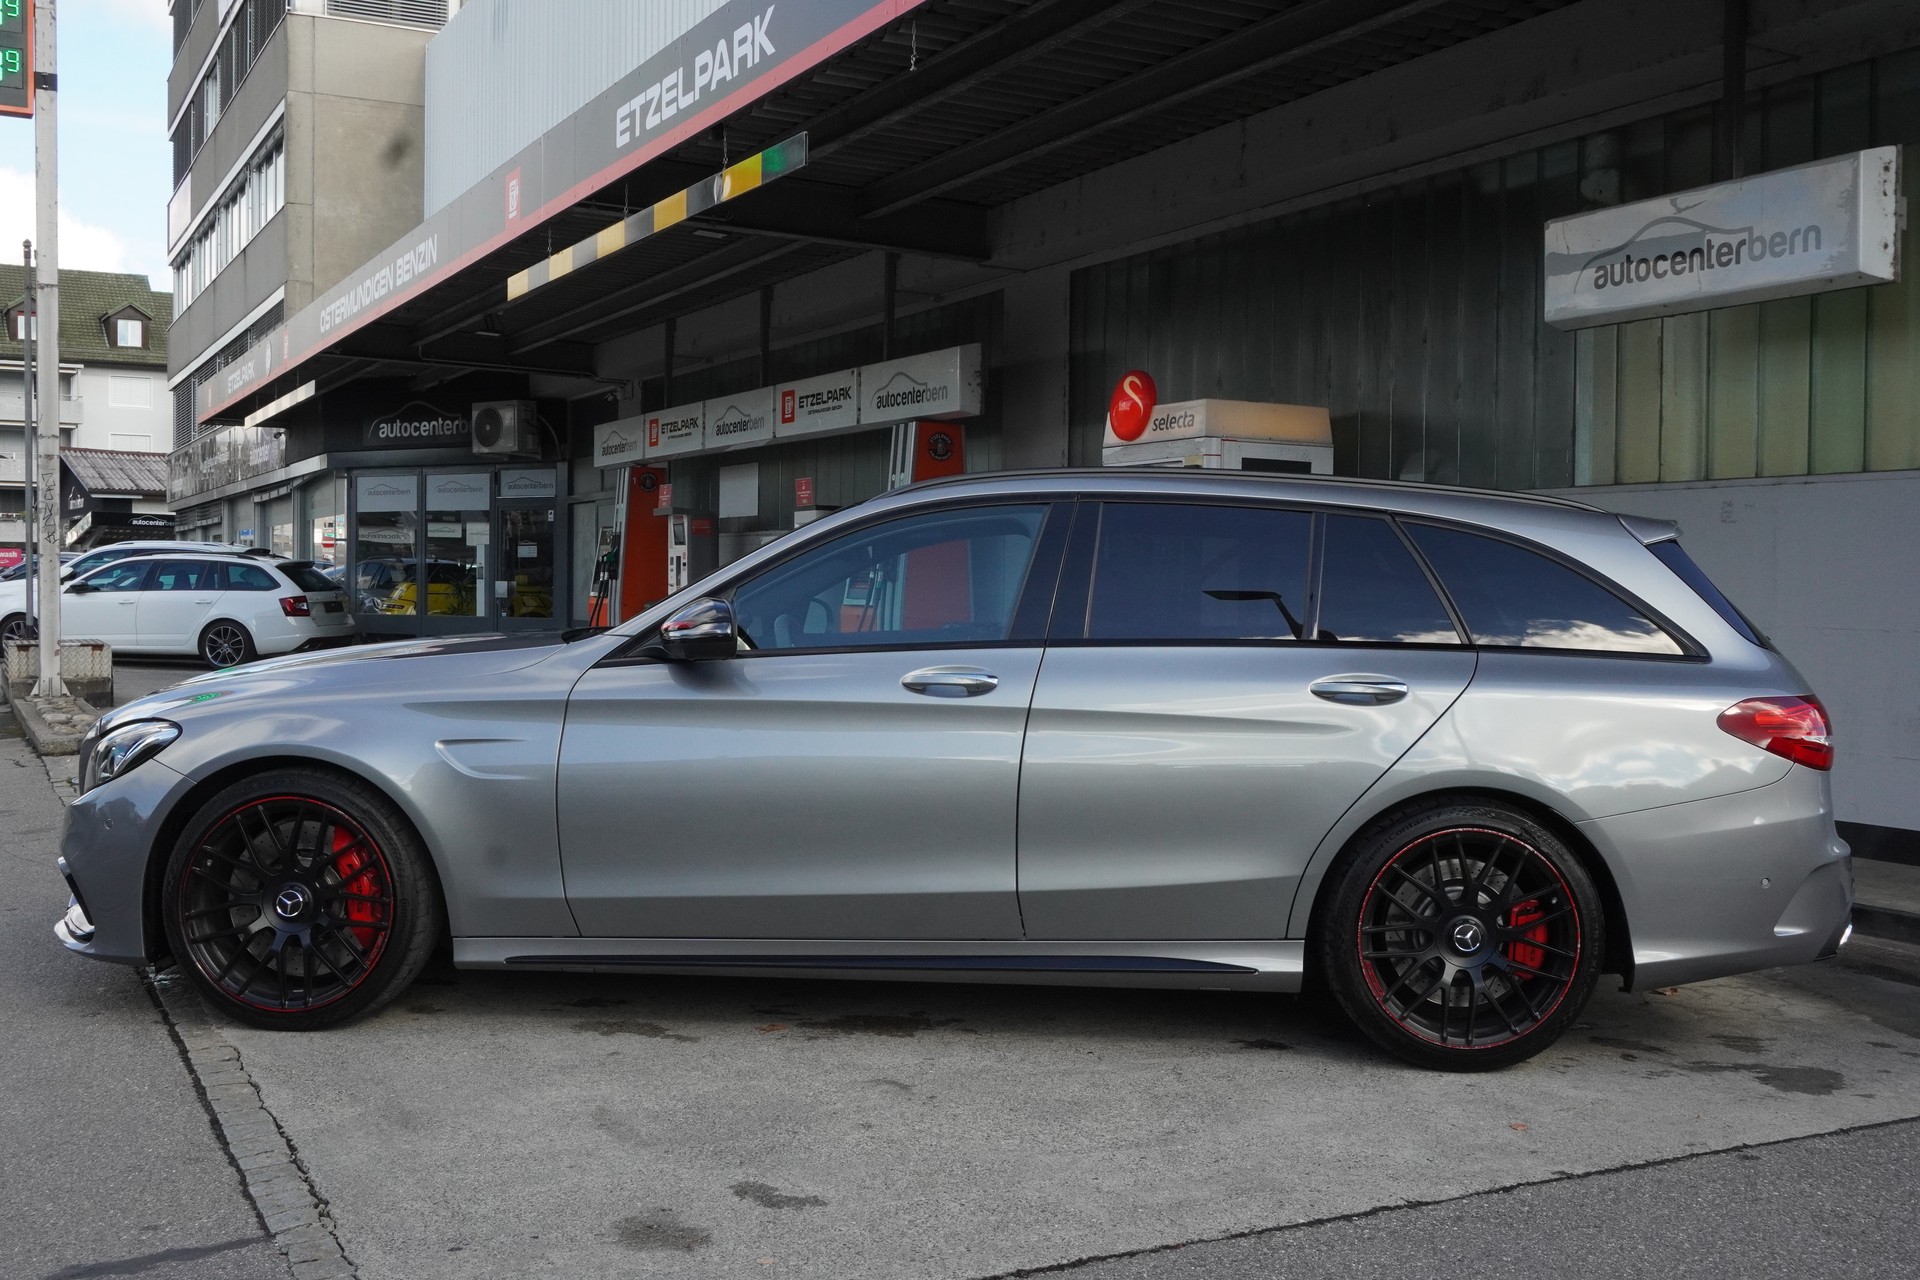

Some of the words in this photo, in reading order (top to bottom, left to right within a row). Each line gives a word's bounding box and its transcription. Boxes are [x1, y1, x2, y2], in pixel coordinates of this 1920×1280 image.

[616, 4, 776, 148] ETZELPARK
[1593, 224, 1822, 290] autocenterbern
[320, 263, 394, 333] OSTERMUNDIGEN
[396, 234, 437, 287] BENZIN
[799, 386, 852, 409] ETZELPARK
[877, 383, 948, 409] autocenterbern
[379, 415, 473, 438] autocenterb
[661, 417, 699, 434] ETZELPARK
[716, 415, 765, 437] autocenterbern
[1152, 411, 1195, 432] selecta
[602, 440, 637, 456] autocenterbern
[367, 487, 411, 496] autocenterbern
[437, 486, 483, 494] autocenterbern
[507, 482, 553, 490] autocenterbern
[132, 519, 176, 527] autocenterber
